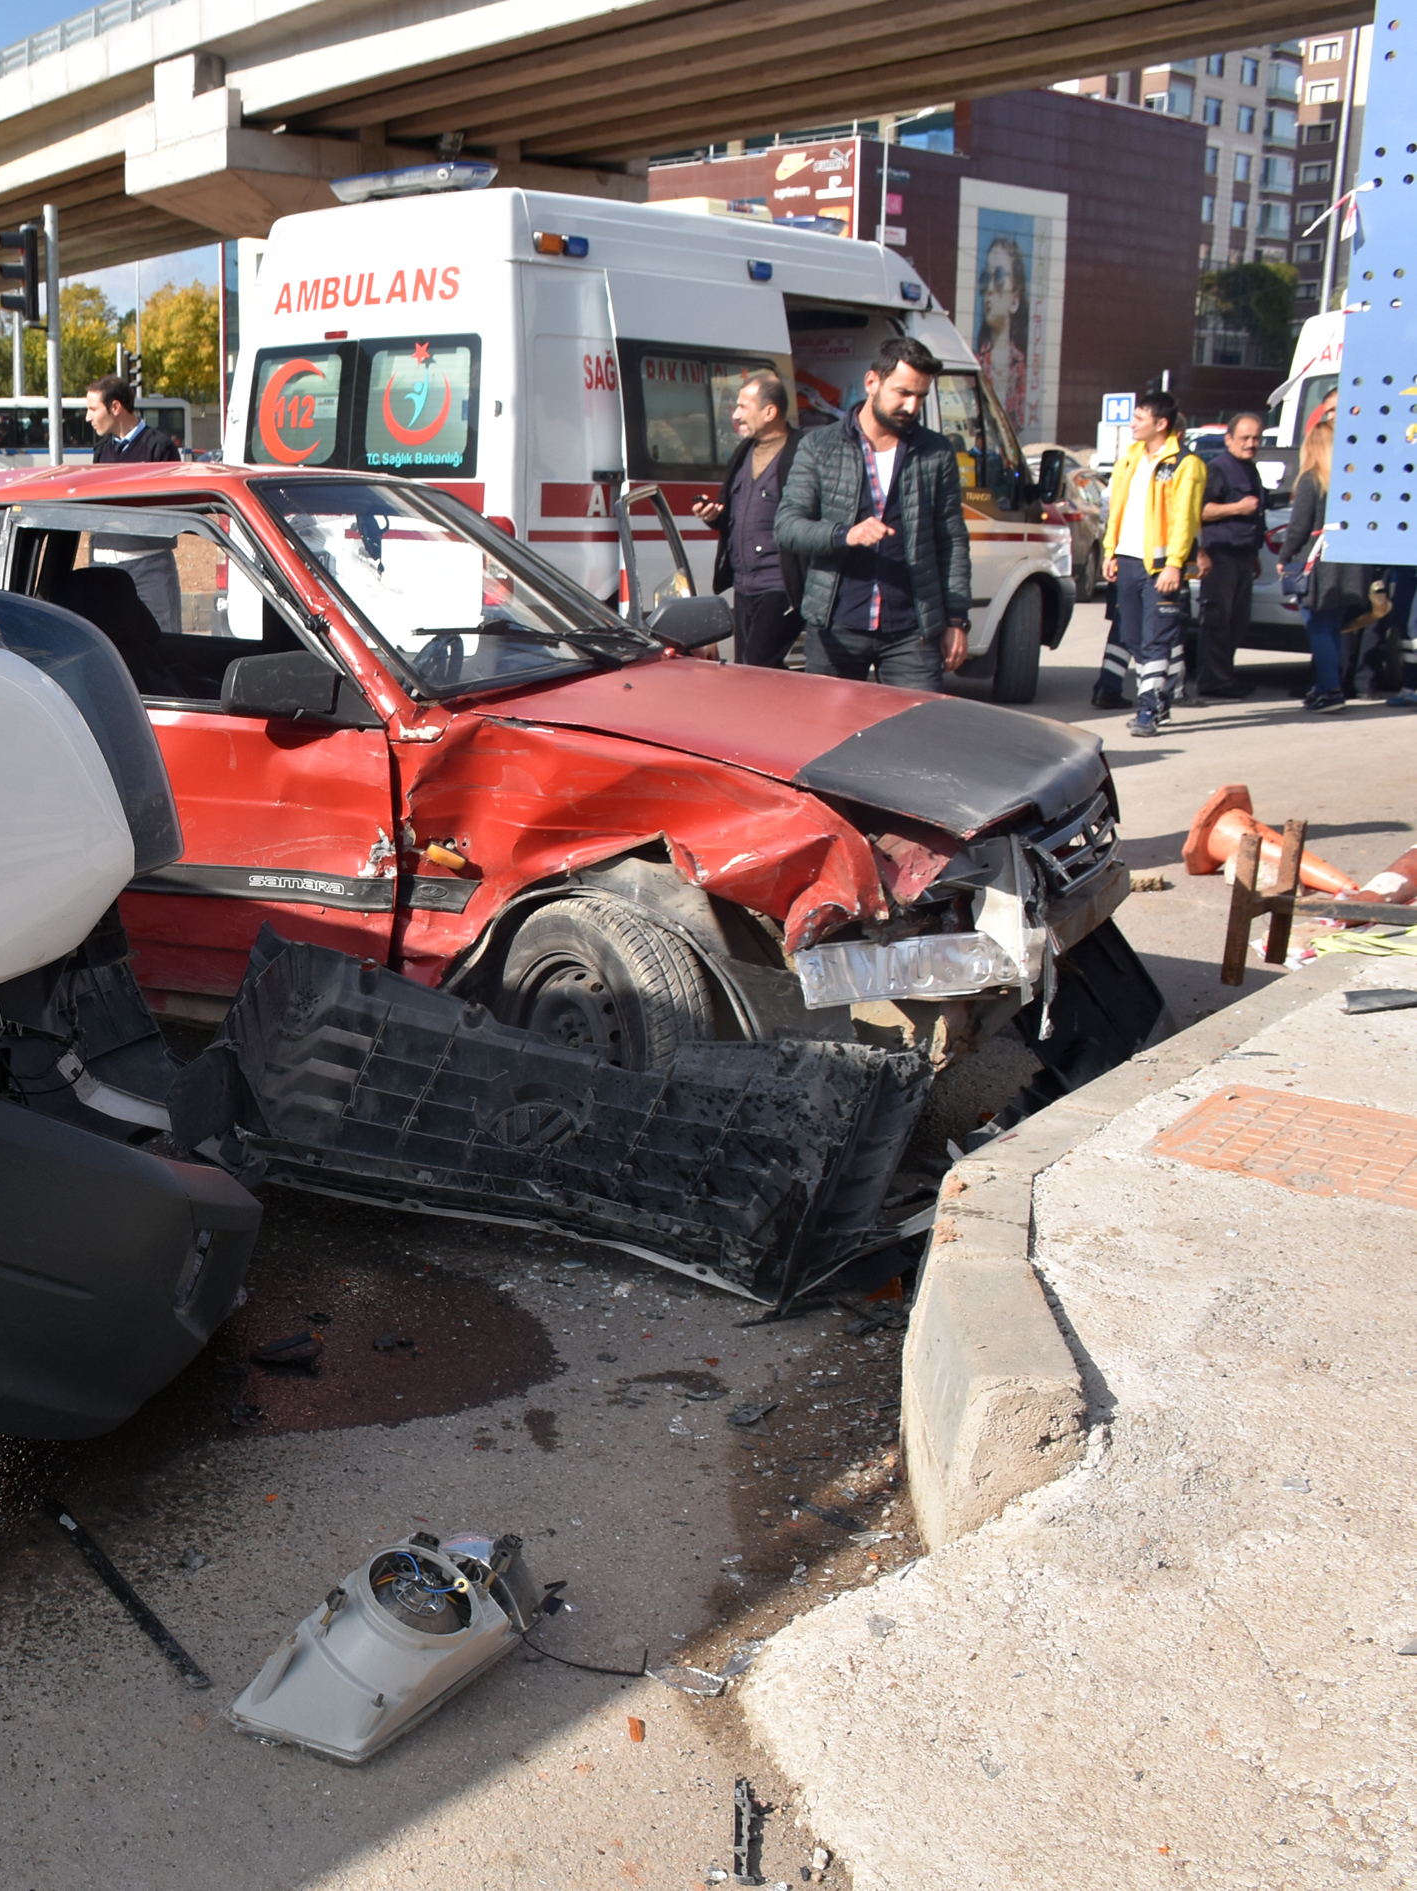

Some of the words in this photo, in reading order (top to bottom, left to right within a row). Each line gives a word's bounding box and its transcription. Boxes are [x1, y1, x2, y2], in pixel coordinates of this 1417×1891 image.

[274, 266, 460, 315] AMBULANS
[274, 395, 316, 429] 112
[1107, 400, 1130, 420] H
[382, 452, 413, 468] Sağlık
[415, 450, 463, 468] Bakanlığı
